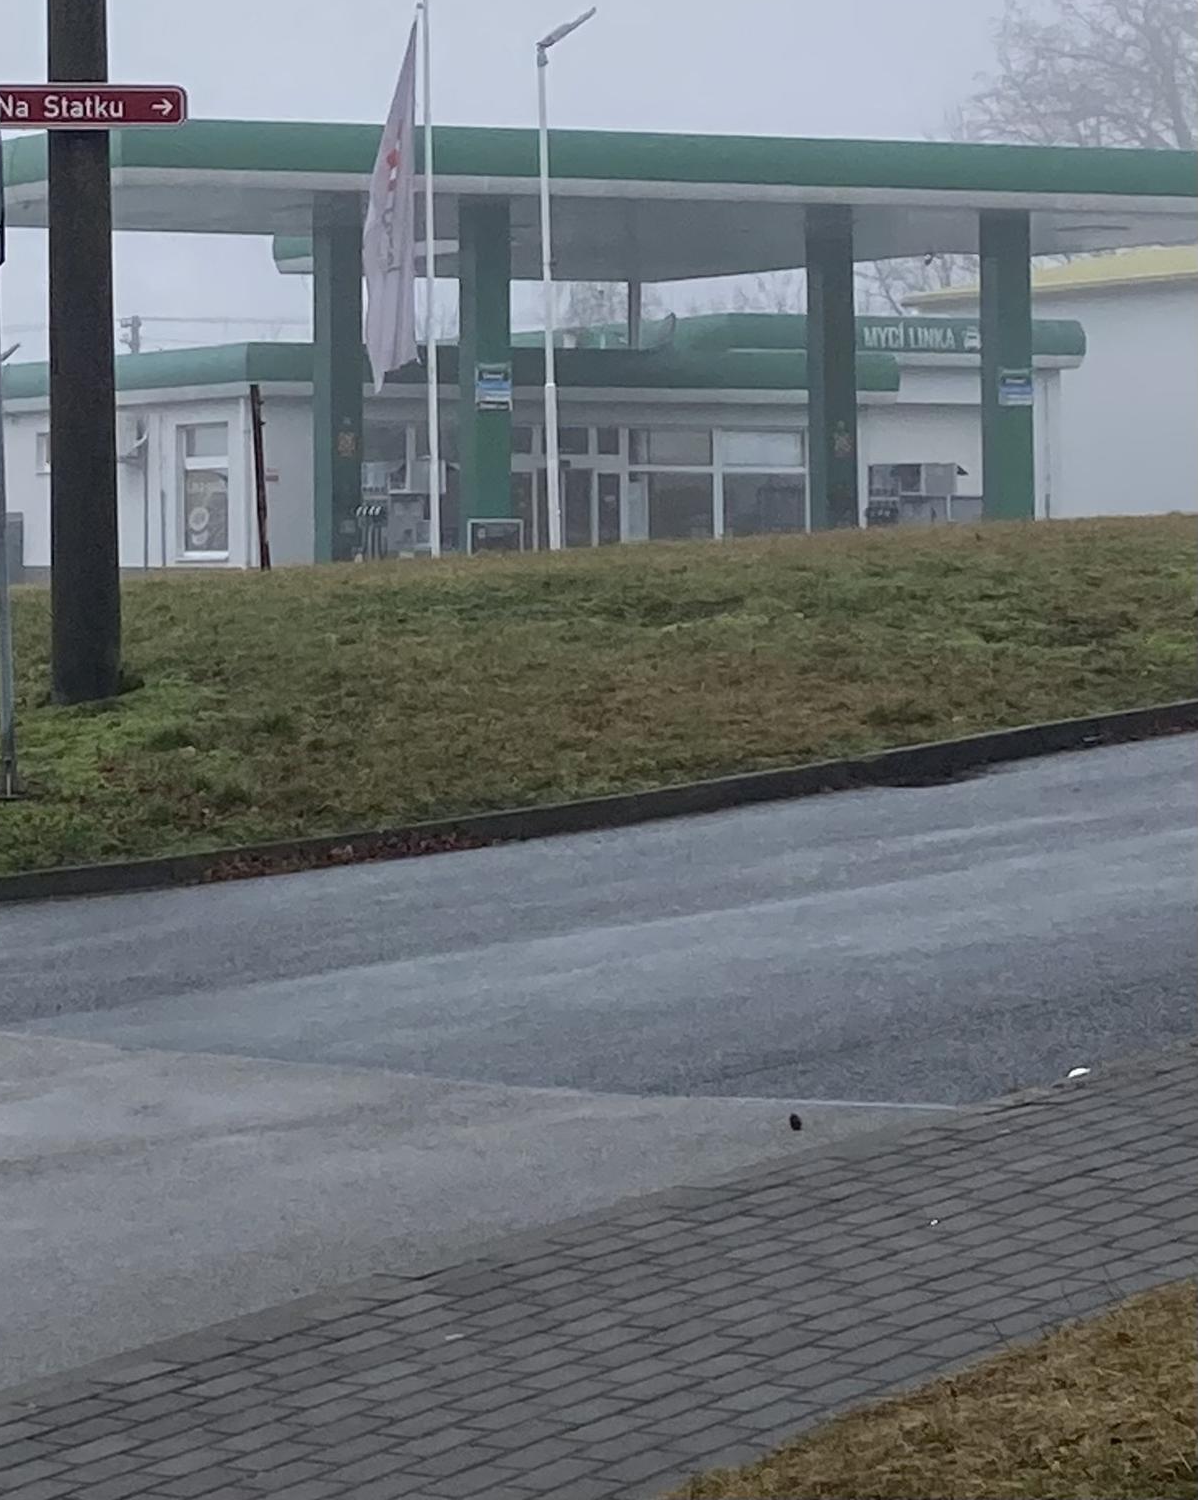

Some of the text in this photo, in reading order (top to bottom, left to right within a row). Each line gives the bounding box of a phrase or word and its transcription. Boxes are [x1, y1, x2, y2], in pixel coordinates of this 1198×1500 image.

[43, 95, 124, 118] Statku
[863, 321, 956, 349] MYCÍ LINKA
